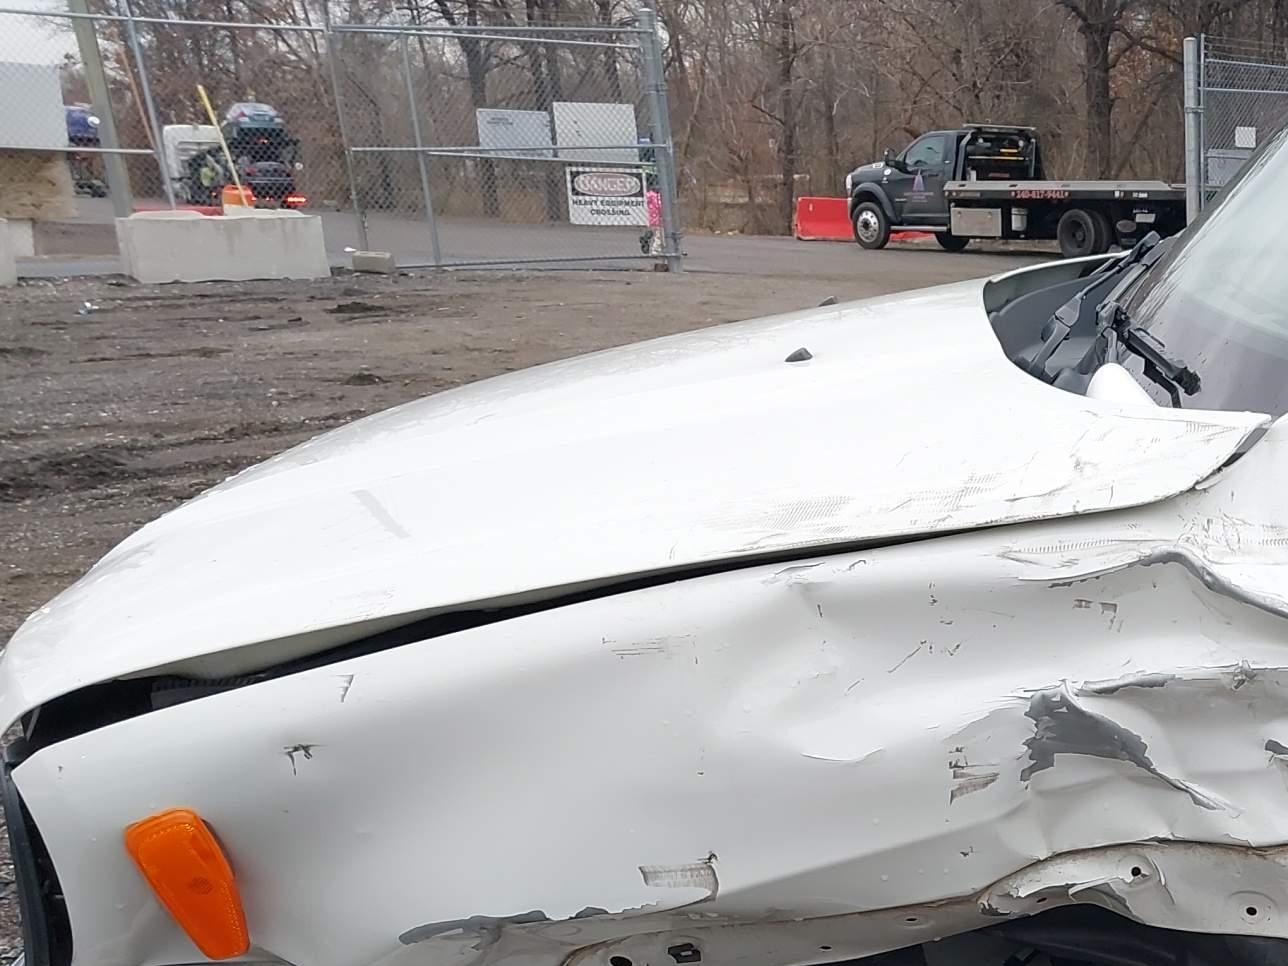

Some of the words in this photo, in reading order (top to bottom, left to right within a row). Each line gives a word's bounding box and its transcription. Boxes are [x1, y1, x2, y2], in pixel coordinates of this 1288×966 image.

[572, 199, 598, 207] HEAVY
[600, 199, 645, 207] EQUIPMENT
[590, 208, 631, 216] CROSSING
